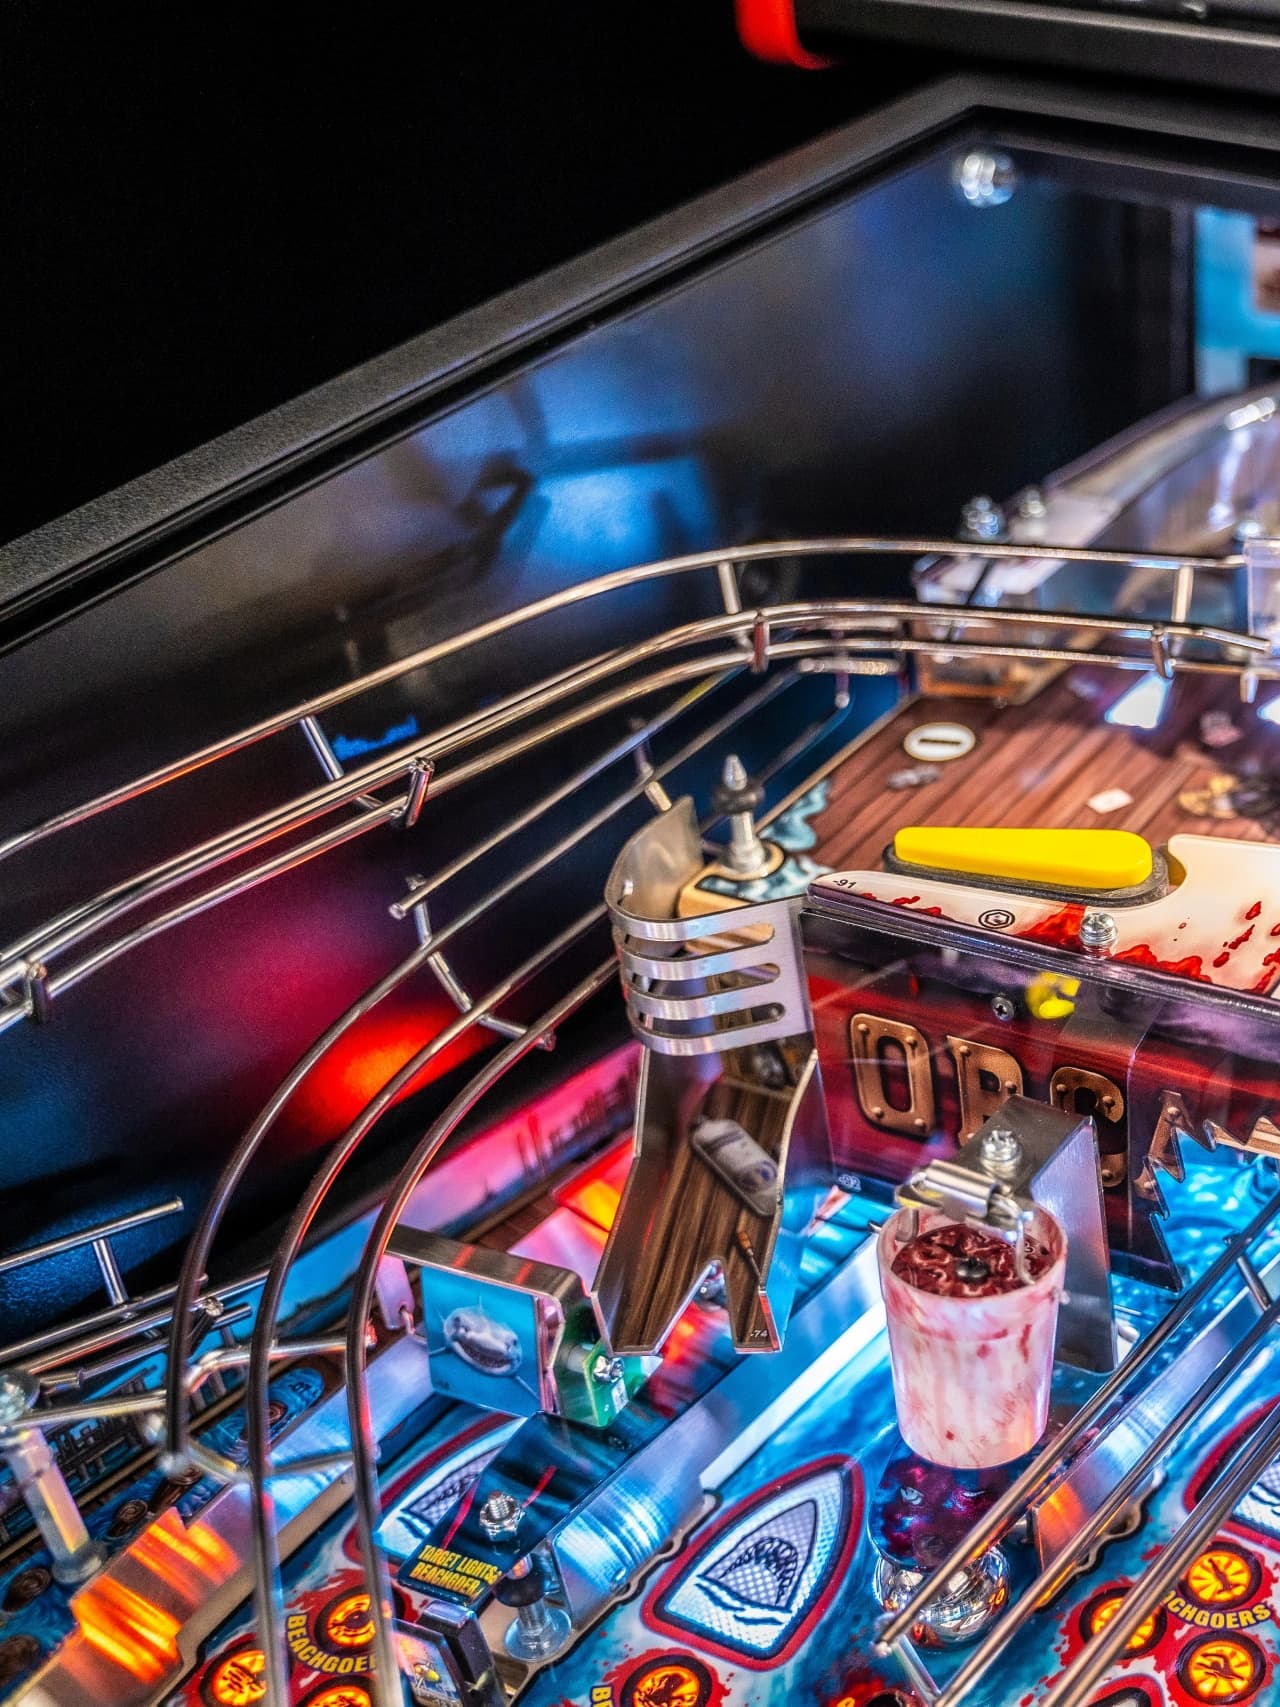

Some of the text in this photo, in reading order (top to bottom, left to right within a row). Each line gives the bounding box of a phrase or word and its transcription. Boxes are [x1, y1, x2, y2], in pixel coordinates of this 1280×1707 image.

[832, 879, 857, 889] -91
[750, 1329, 769, 1338] -74
[418, 1544, 462, 1569] TARGET
[1164, 1589, 1272, 1630] CHGOERS
[287, 1614, 379, 1674] BEACHGOE
